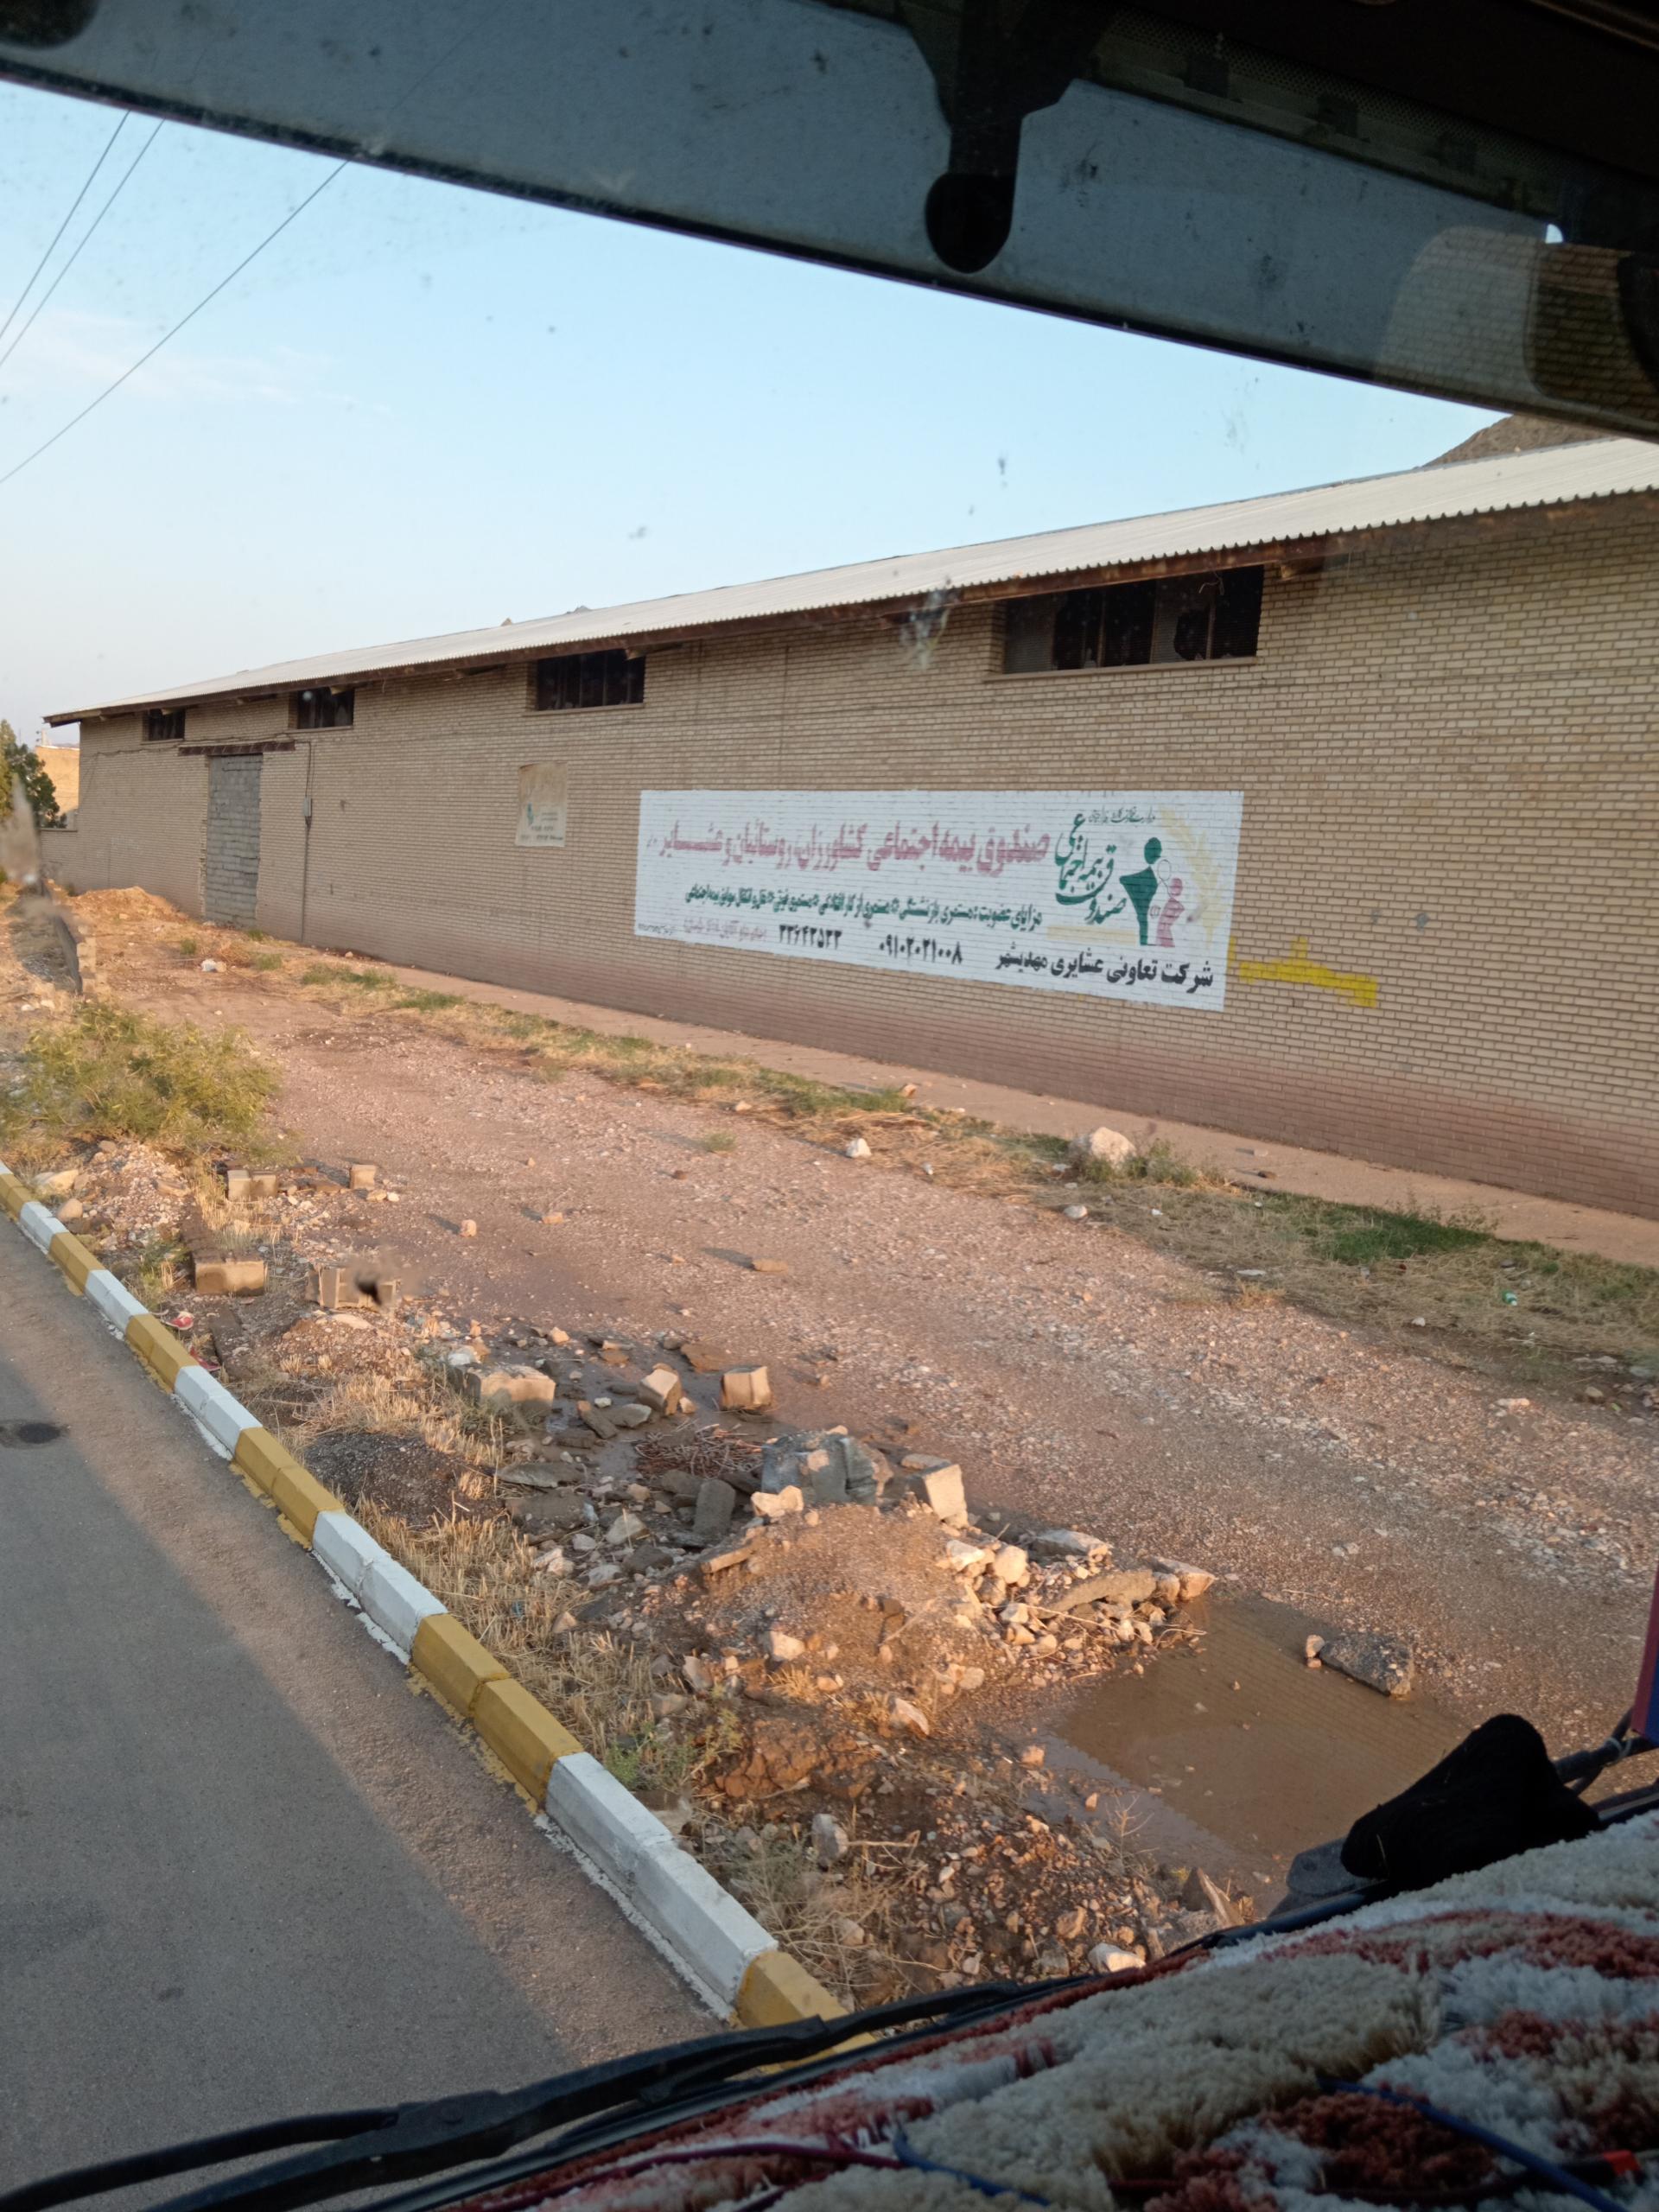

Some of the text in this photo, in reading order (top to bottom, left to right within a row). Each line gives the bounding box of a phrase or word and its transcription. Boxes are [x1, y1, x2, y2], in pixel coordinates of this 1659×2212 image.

[867, 820, 939, 872] اجتماعی
[938, 829, 976, 872] بیمه
[976, 823, 1051, 878] صندوق
[995, 941, 1214, 994] شرکت تعاونی عشایری مهدیشهر
